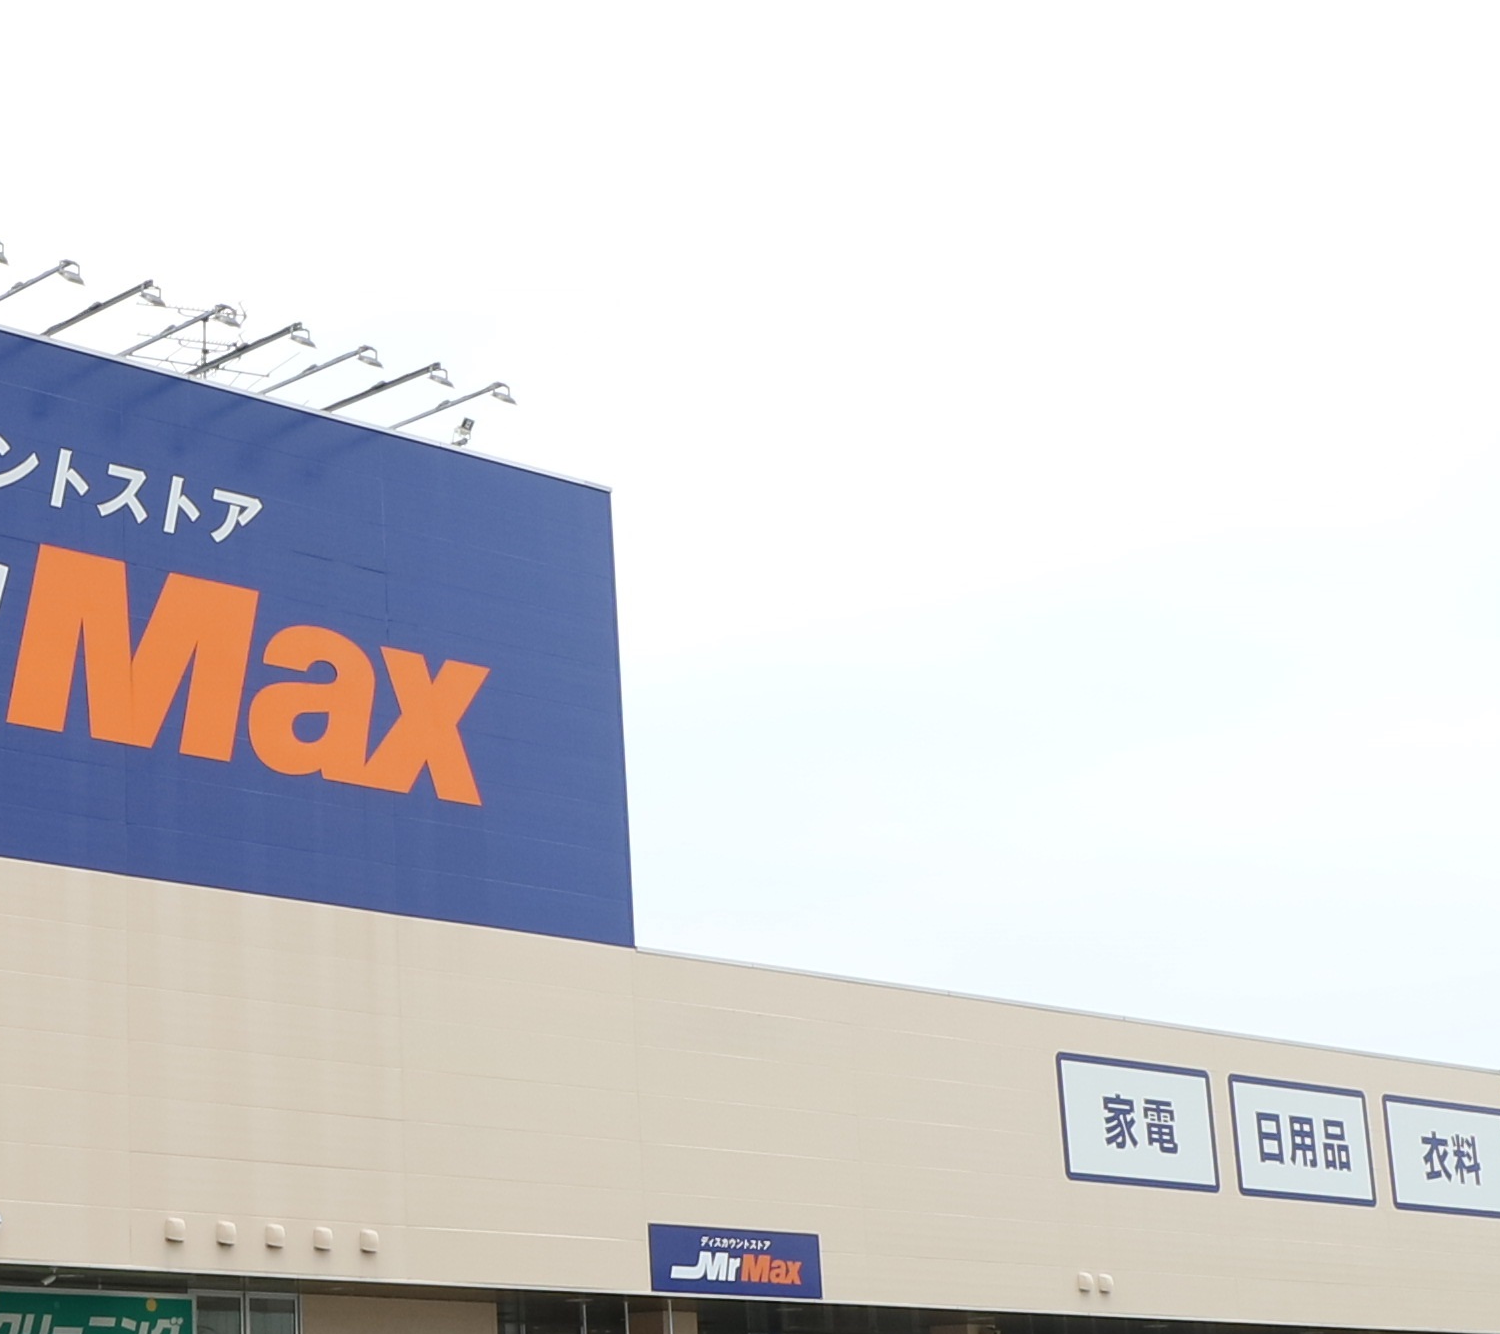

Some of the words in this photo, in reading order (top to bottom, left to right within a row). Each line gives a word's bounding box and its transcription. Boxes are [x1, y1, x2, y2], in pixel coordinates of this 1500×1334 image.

[1103, 1094, 1180, 1156] 家電
[1256, 1111, 1352, 1172] 日用品
[1421, 1131, 1482, 1186] 衣料
[670, 1250, 802, 1285] MrMax
[700, 1236, 771, 1250] ディスカウントストア
